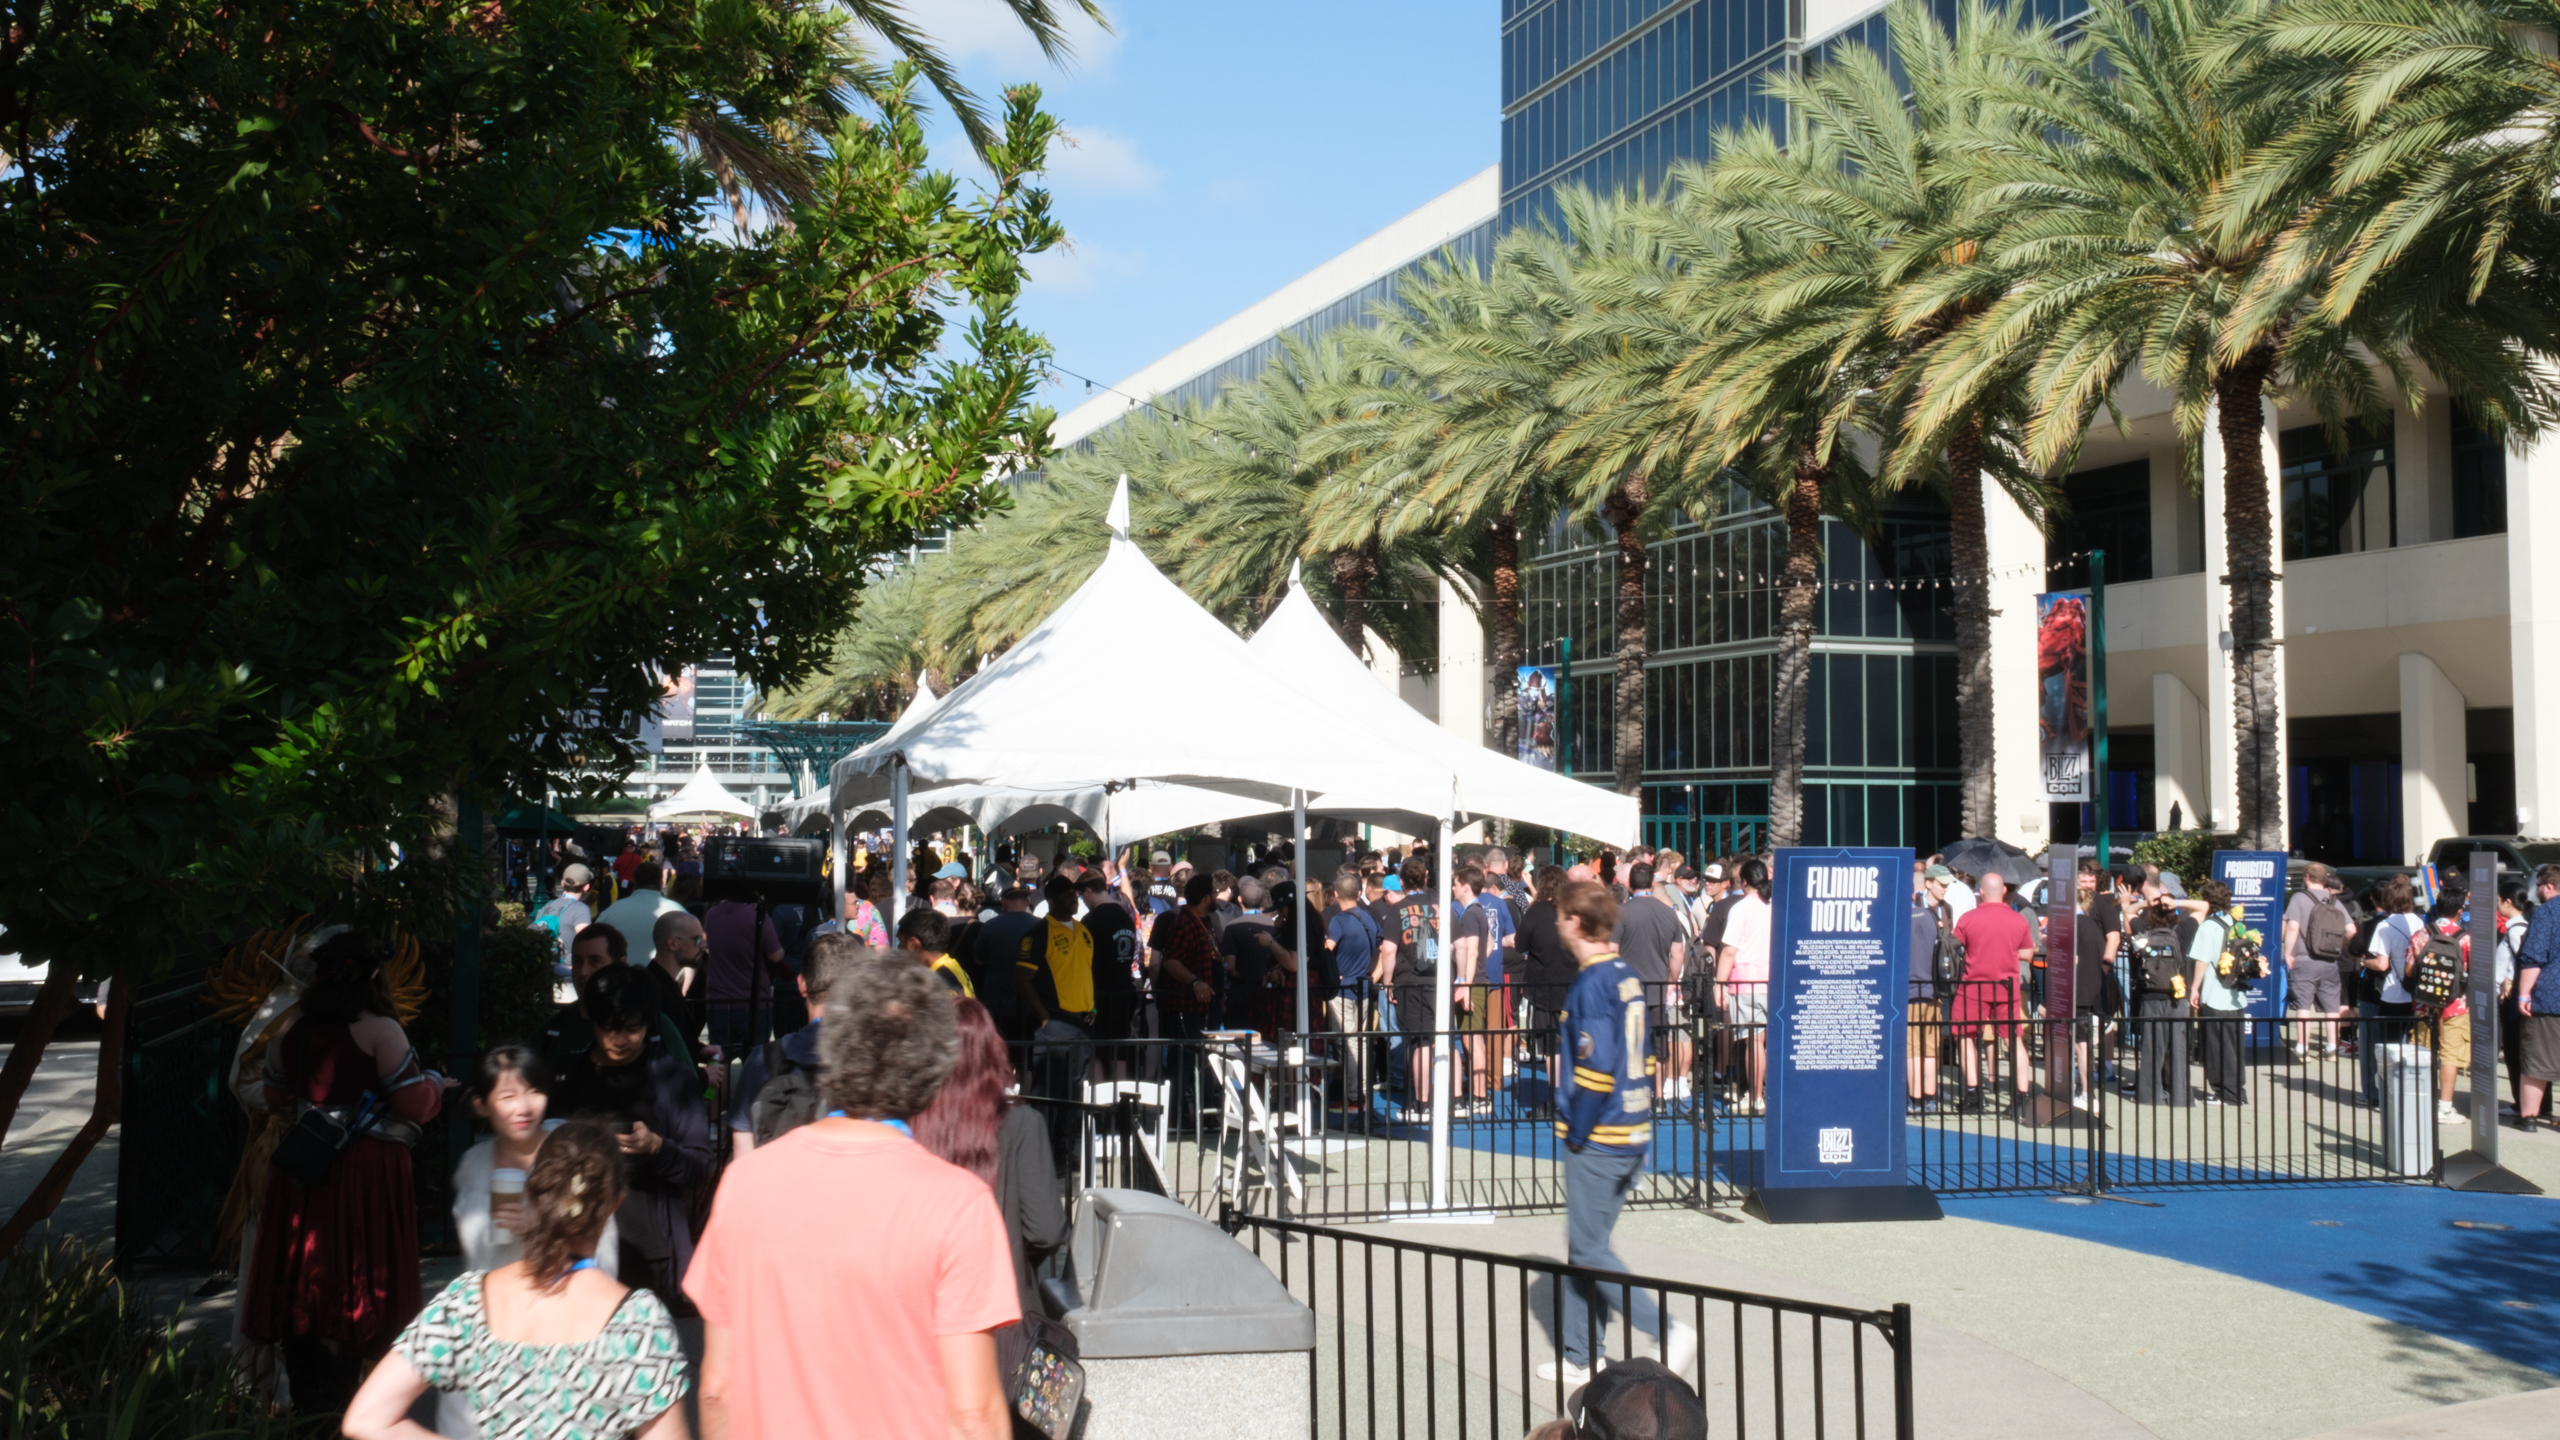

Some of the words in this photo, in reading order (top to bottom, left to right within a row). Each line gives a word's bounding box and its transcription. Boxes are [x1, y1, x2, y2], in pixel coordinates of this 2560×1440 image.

[2049, 756, 2079, 781] BLIZZ
[2049, 783, 2079, 793] CON
[2225, 861, 2274, 878] PROHIBITED
[1807, 867, 1879, 898] FILMING
[2234, 879, 2261, 895] ITEMS
[1400, 904, 1440, 919] SILLY
[1811, 900, 1872, 932] NOTICE
[1822, 1131, 1849, 1152] BLIZZ
